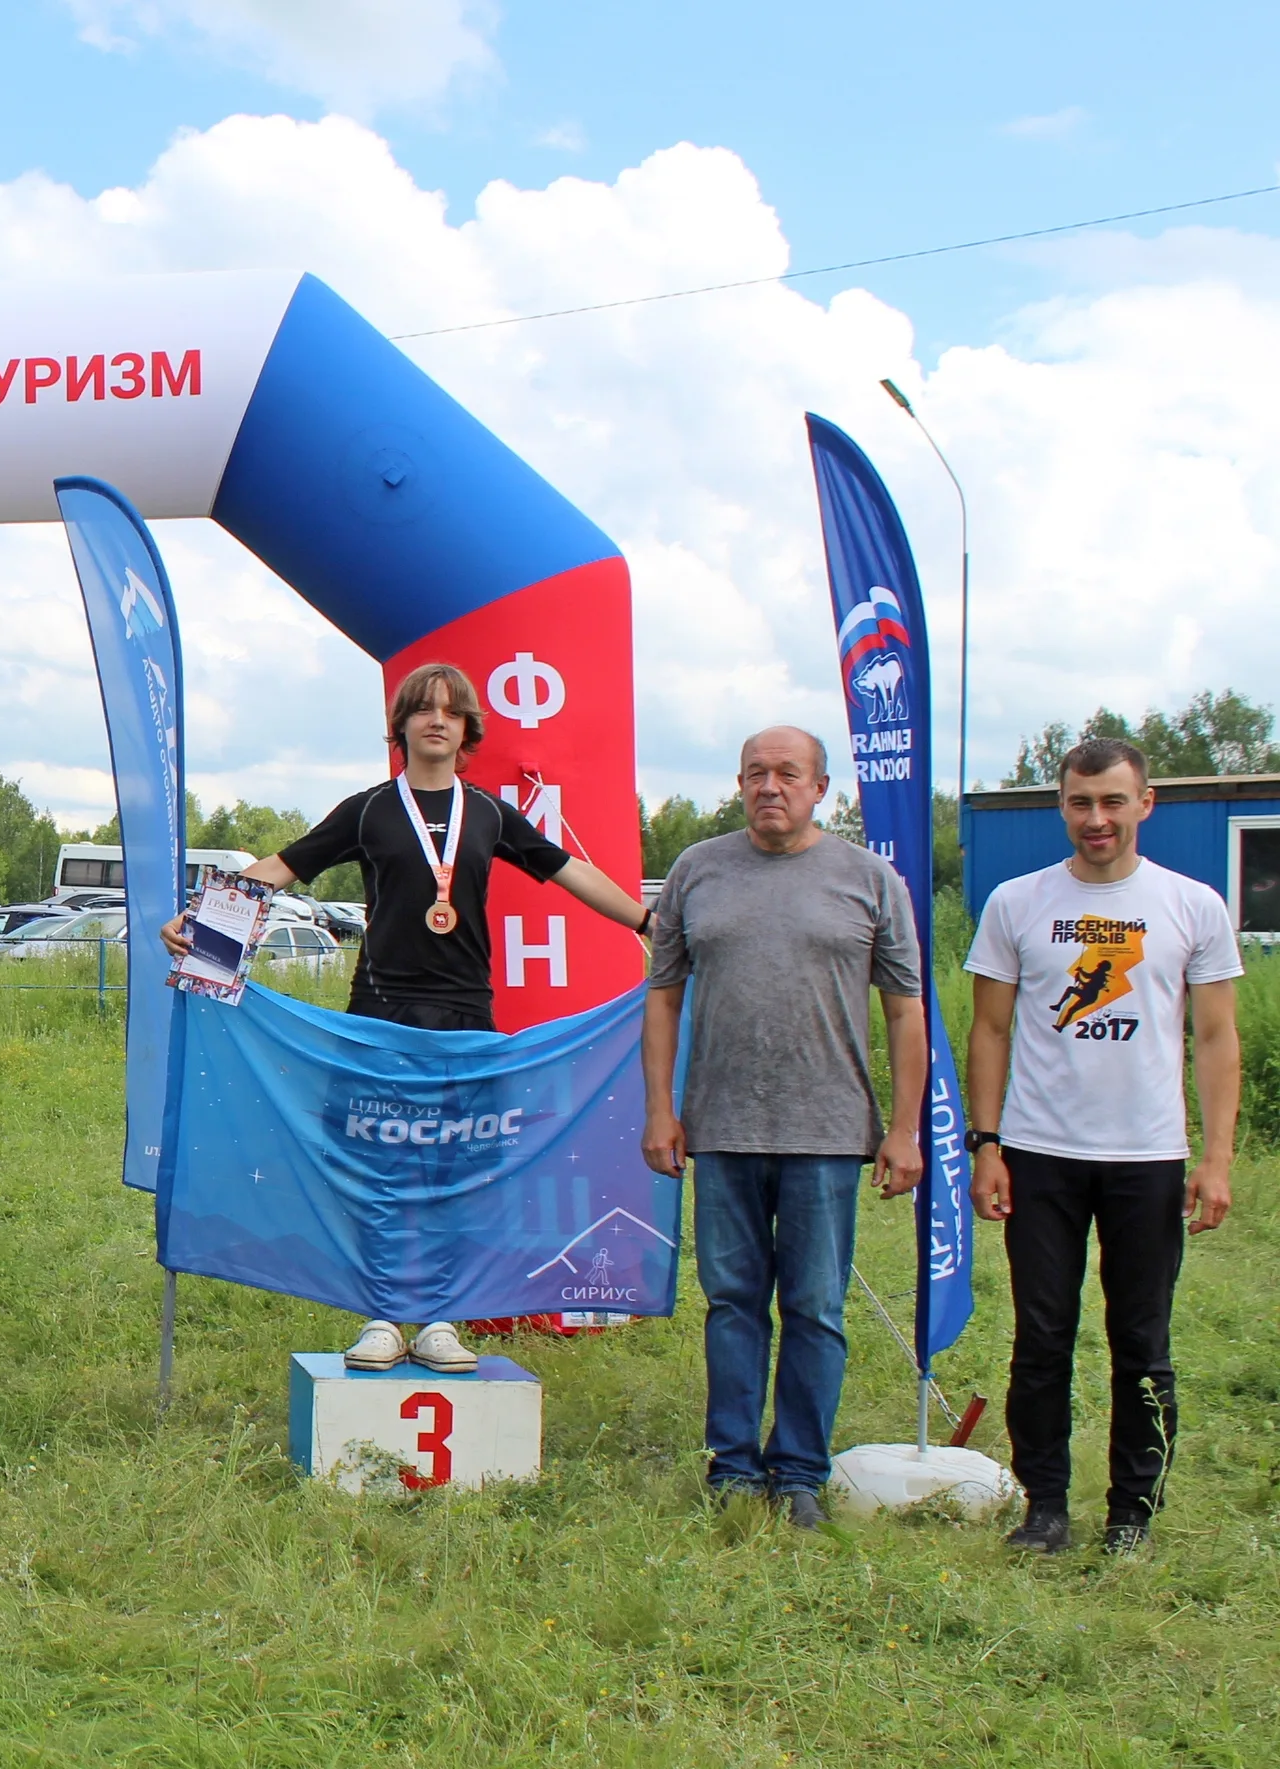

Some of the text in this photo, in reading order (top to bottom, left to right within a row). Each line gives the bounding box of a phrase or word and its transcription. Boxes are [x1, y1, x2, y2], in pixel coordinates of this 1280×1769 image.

[207, 898, 251, 917] ГРАМОТА
[1053, 918, 1147, 933] ВЕСЕННИЙ
[1051, 932, 1126, 944] ПРИЗЫВ
[1075, 1018, 1139, 1041] 2017
[345, 1108, 523, 1145] КОСМОС
[561, 1286, 637, 1302] СИРИУС
[398, 1392, 453, 1491] 3
